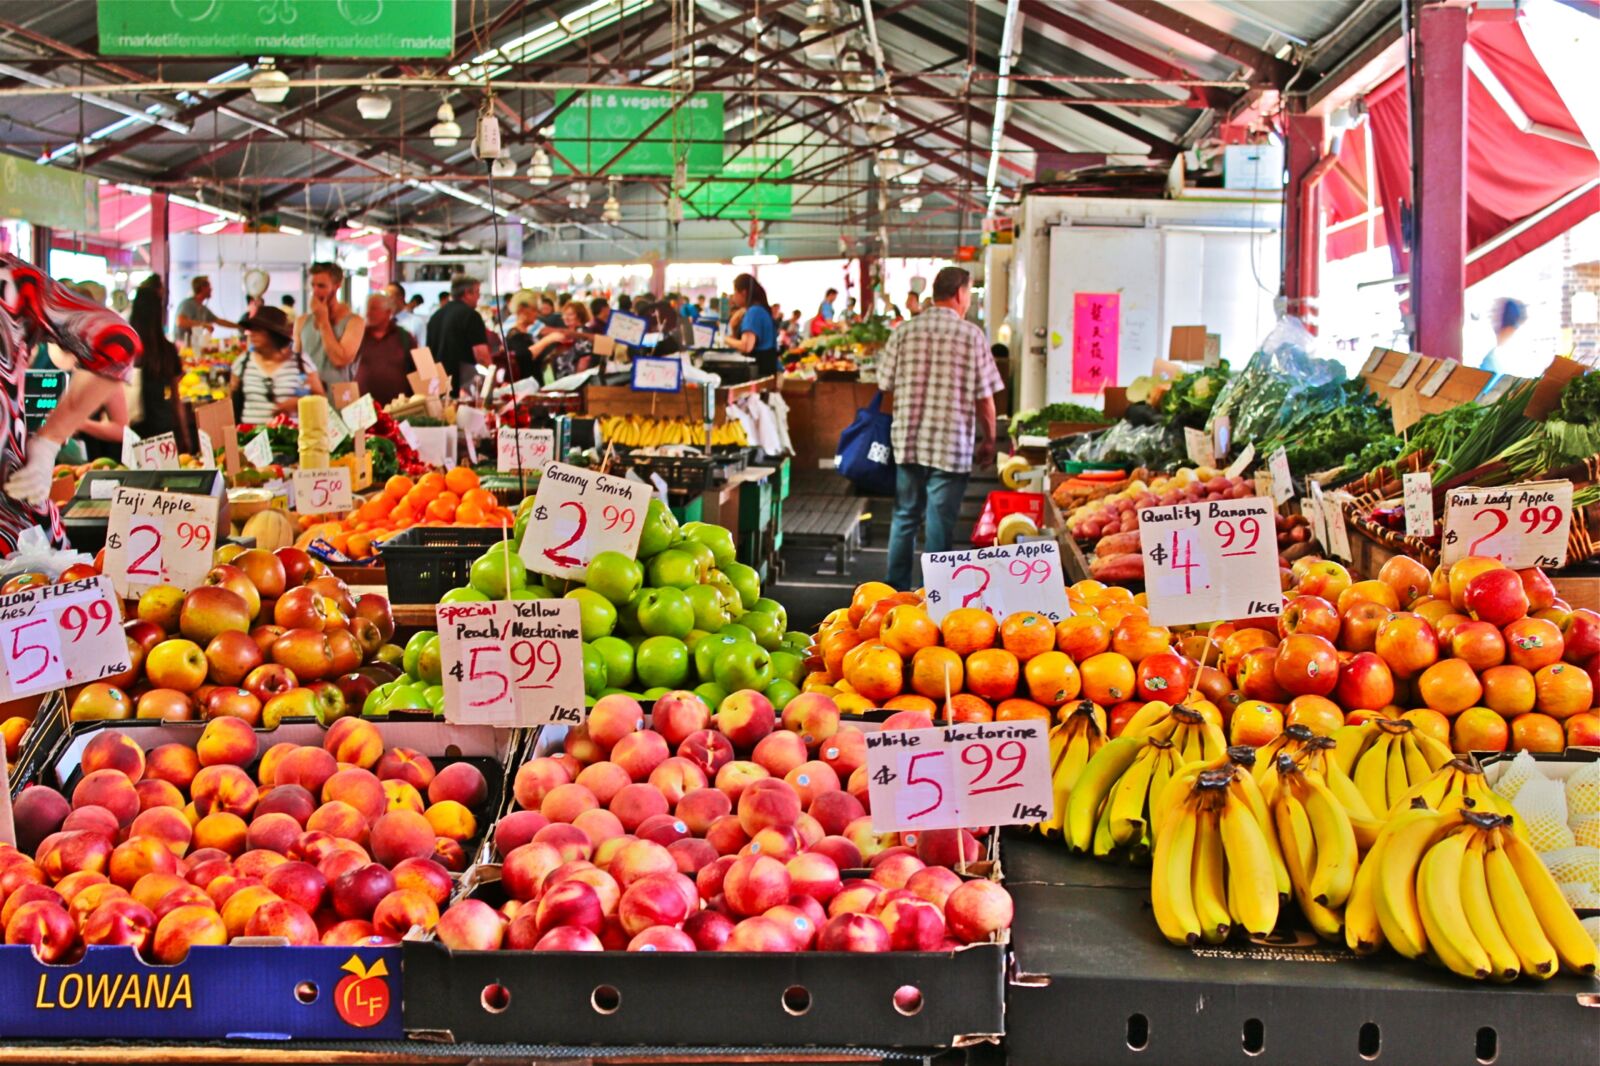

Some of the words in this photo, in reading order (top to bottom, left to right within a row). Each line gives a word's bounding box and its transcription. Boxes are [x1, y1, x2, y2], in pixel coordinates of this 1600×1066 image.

[547, 465, 588, 495] Granny
[595, 476, 633, 500] Smith
[117, 489, 145, 515] Fuji
[152, 495, 195, 514] Apple
[1451, 494, 1478, 507] Pink
[1485, 491, 1514, 510] Lady
[1519, 491, 1555, 506] Apple
[1142, 506, 1201, 526] Quality
[1209, 502, 1267, 519] Banana
[930, 551, 971, 568] Royal
[977, 546, 1010, 560] Gala
[1015, 543, 1055, 558] Apple
[43, 577, 99, 600] FLESH
[513, 604, 560, 618] Yellow
[944, 725, 1037, 743] Nectarine
[36, 973, 192, 1009] LOWANA
[356, 985, 382, 1017] LF
